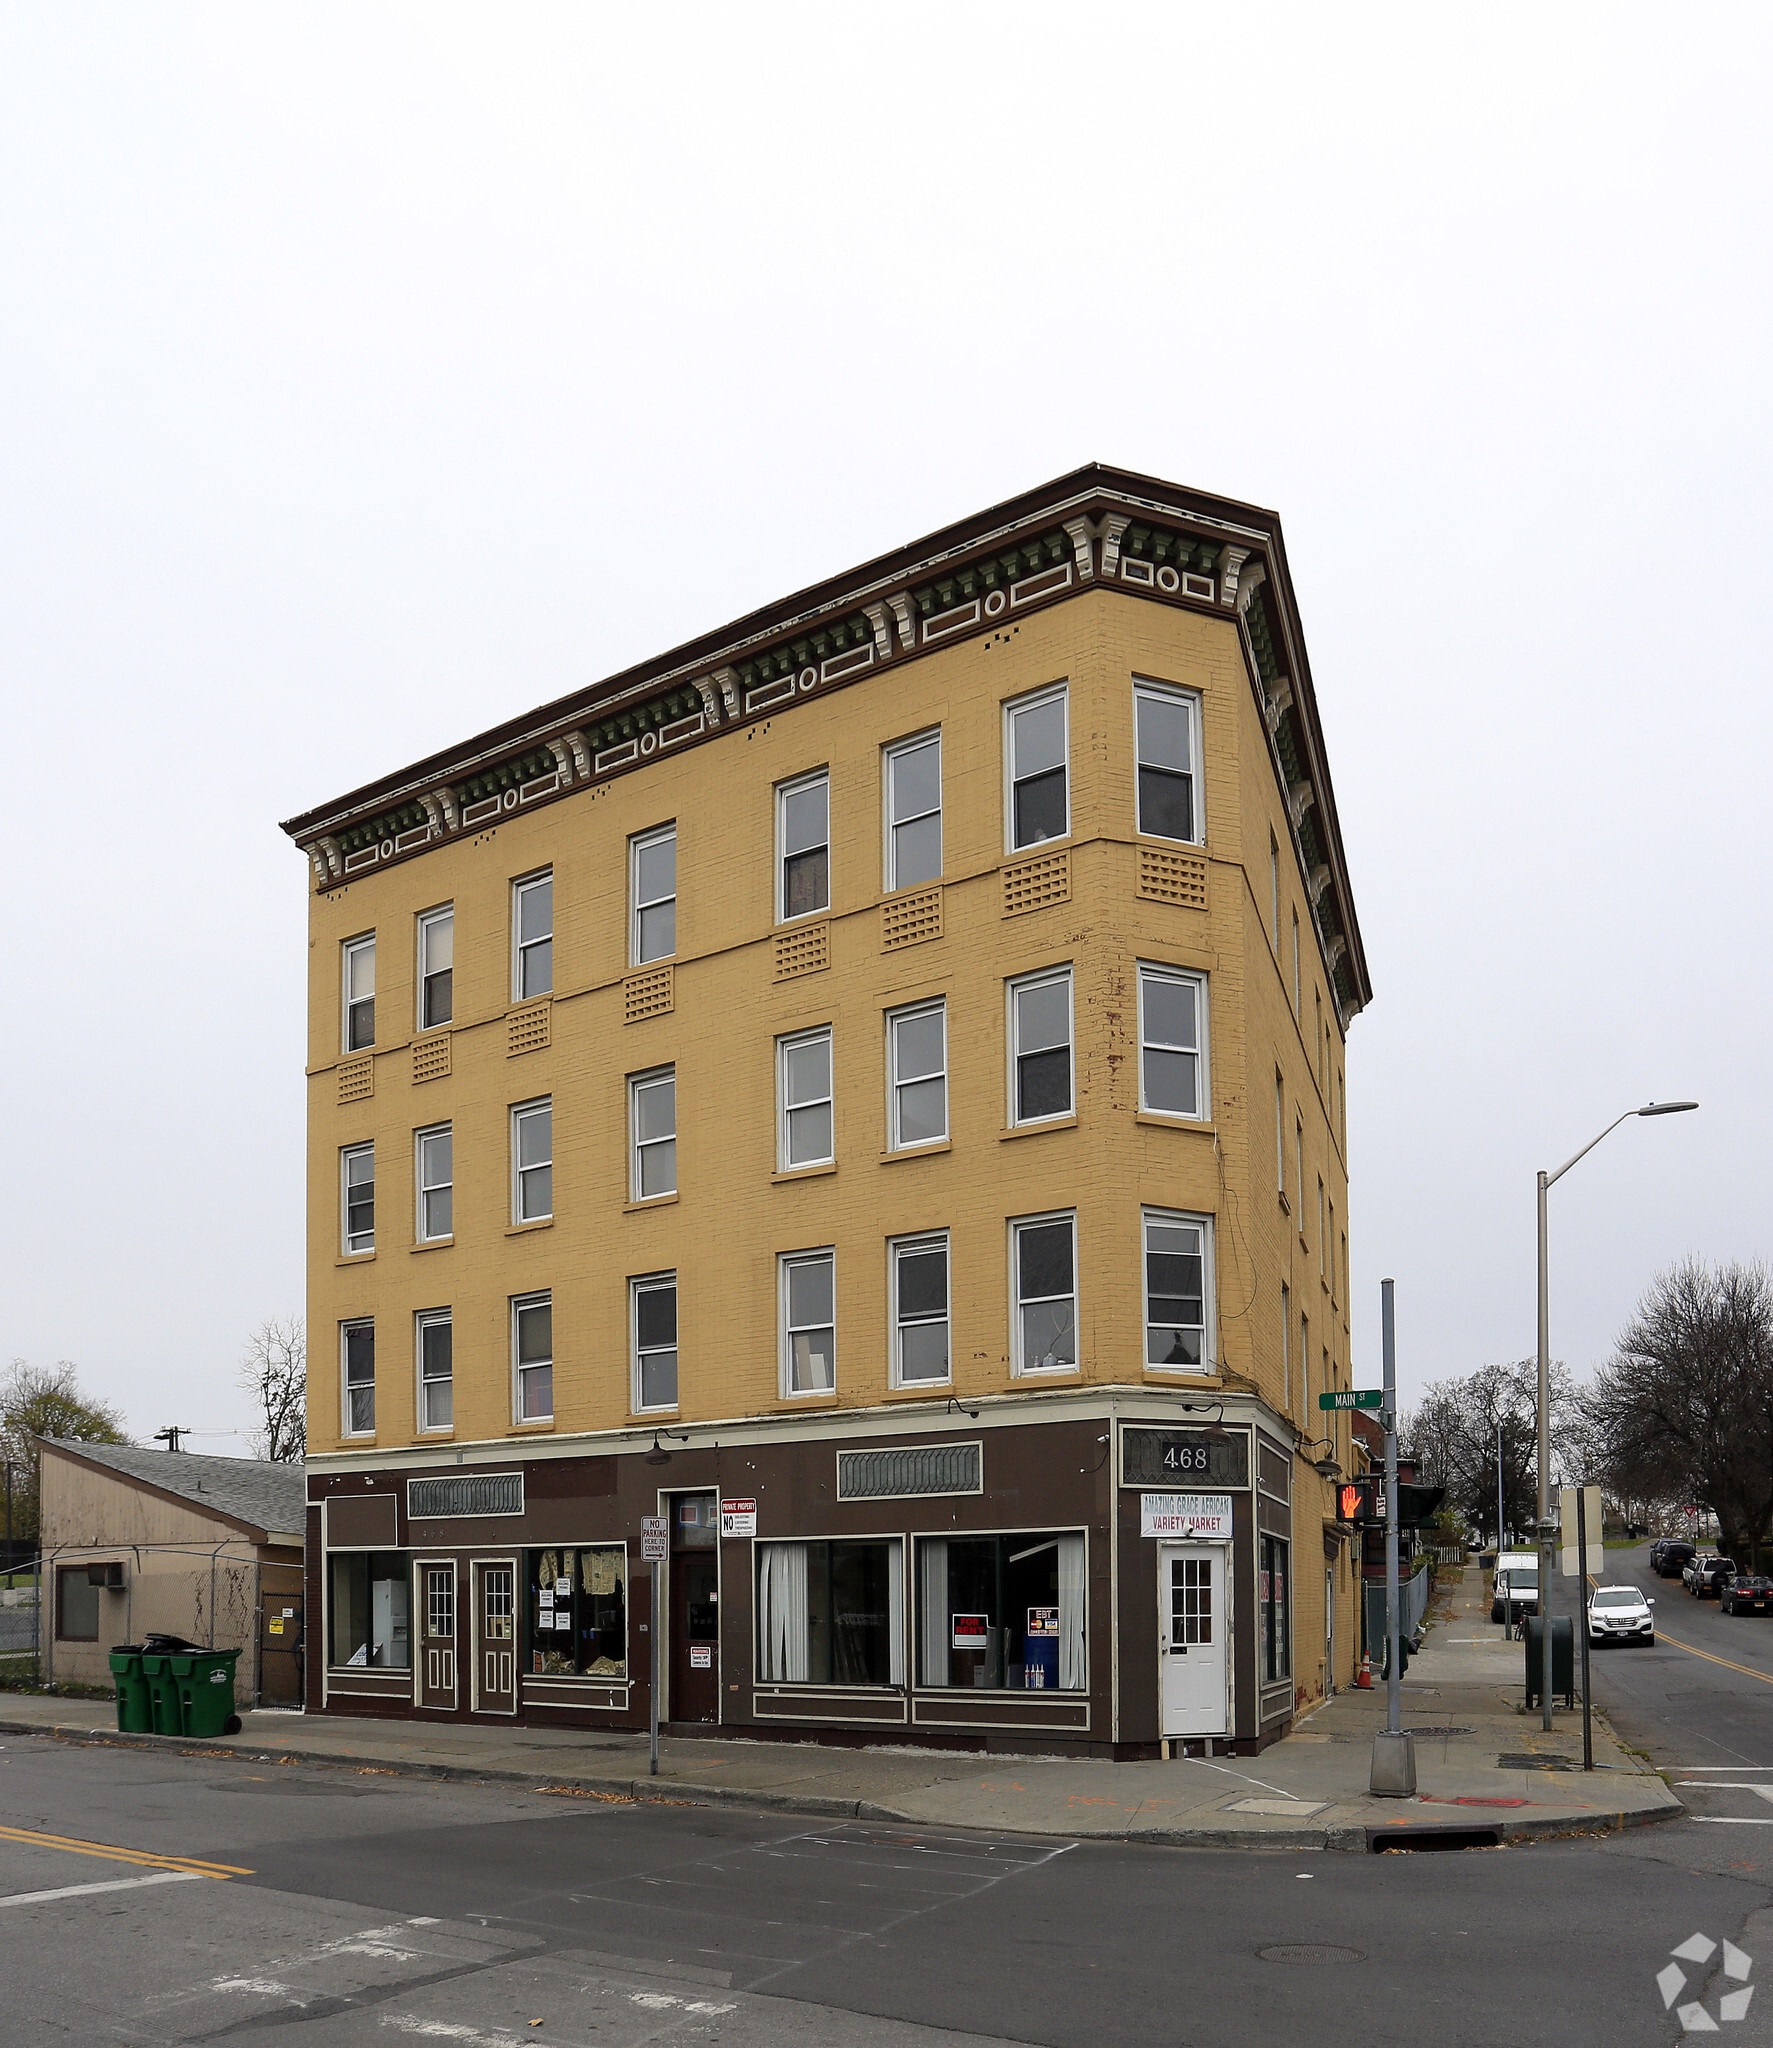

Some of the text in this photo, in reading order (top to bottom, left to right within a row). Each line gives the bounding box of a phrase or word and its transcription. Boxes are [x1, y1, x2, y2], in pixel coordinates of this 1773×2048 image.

[1335, 1393, 1366, 1408] MAIN ST
[1164, 1447, 1207, 1469] 468
[722, 1502, 755, 1511] PRIVATE PROPERTY
[1144, 1495, 1229, 1516] AMAZING GRACE AFRICAN
[649, 1519, 660, 1529] NO
[723, 1515, 734, 1531] NO
[1153, 1516, 1186, 1530] VARIETY
[643, 1529, 667, 1538] PARKING
[1035, 1610, 1053, 1619] EBT
[959, 1617, 980, 1626] FOR
[955, 1625, 985, 1635] RENT
